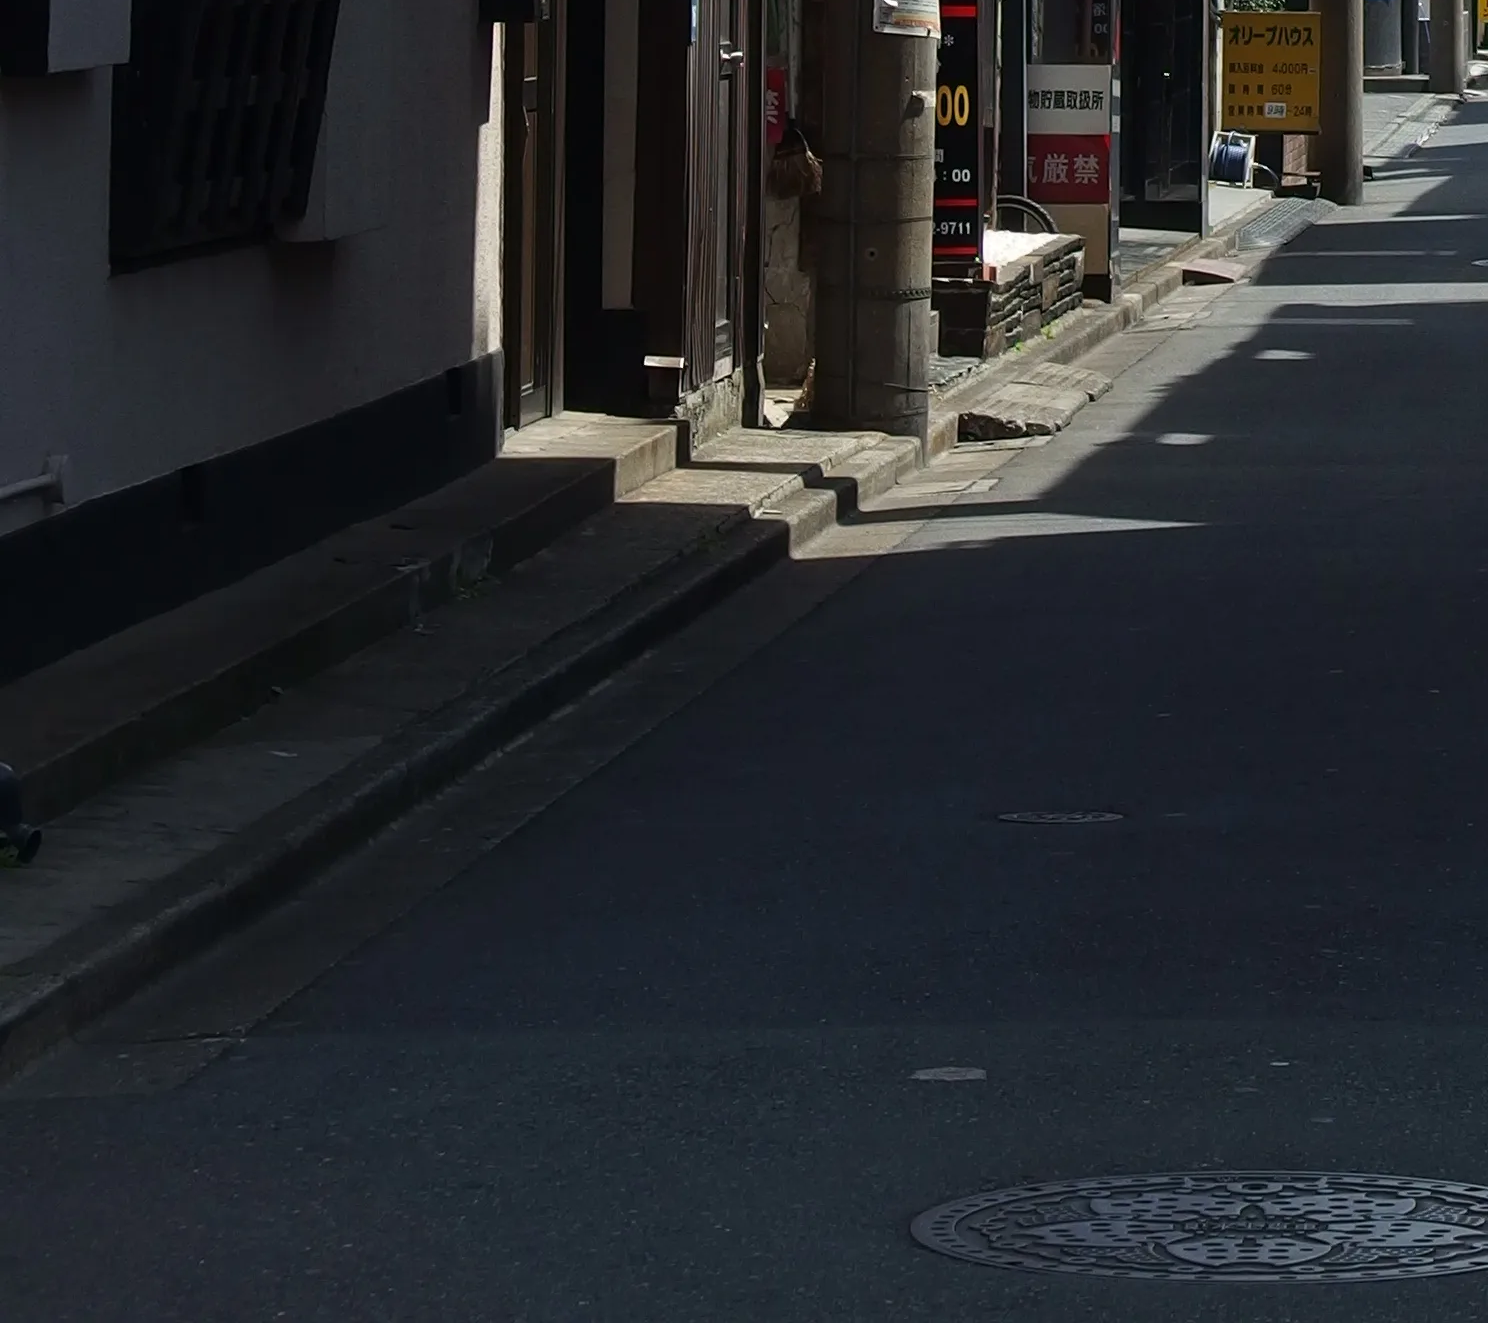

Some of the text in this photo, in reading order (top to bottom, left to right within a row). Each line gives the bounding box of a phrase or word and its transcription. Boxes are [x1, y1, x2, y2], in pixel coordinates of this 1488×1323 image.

[1229, 25, 1314, 47] オリーブハウス
